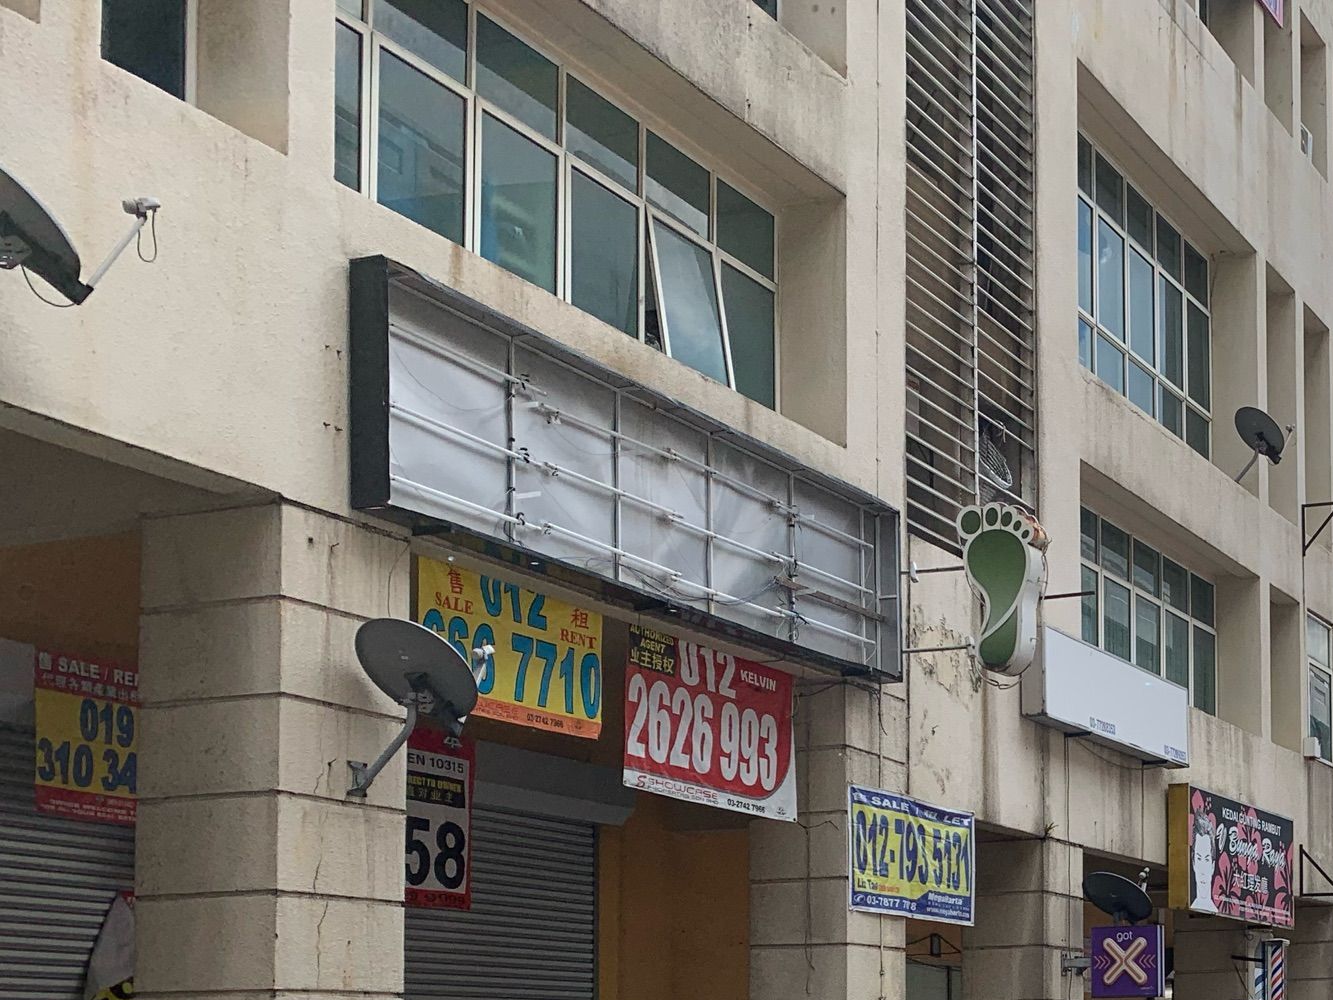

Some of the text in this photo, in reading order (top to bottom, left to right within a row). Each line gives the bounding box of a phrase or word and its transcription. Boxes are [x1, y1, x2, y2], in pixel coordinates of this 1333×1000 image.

[447, 569, 465, 595] 售
[435, 591, 474, 615] SALE
[480, 575, 548, 632] 012
[570, 608, 589, 629] 租
[560, 628, 597, 650] RENT
[630, 623, 674, 646] AUTHORIZED
[640, 640, 666, 654] AGENT
[58, 656, 100, 679] SALE
[422, 608, 600, 719] 66 7710
[630, 649, 675, 674] 业主授权
[679, 639, 777, 699] 012 KELVIN
[80, 698, 134, 748] 019
[627, 673, 778, 792] 2626 993
[37, 737, 94, 788] 310
[429, 757, 464, 774] 10315
[647, 778, 719, 800] SHOWCASE
[871, 796, 910, 812] SALE
[1222, 807, 1282, 837] KEDAI GUNTING RAMBUT
[405, 816, 466, 889] 58
[1116, 930, 1133, 941] got
